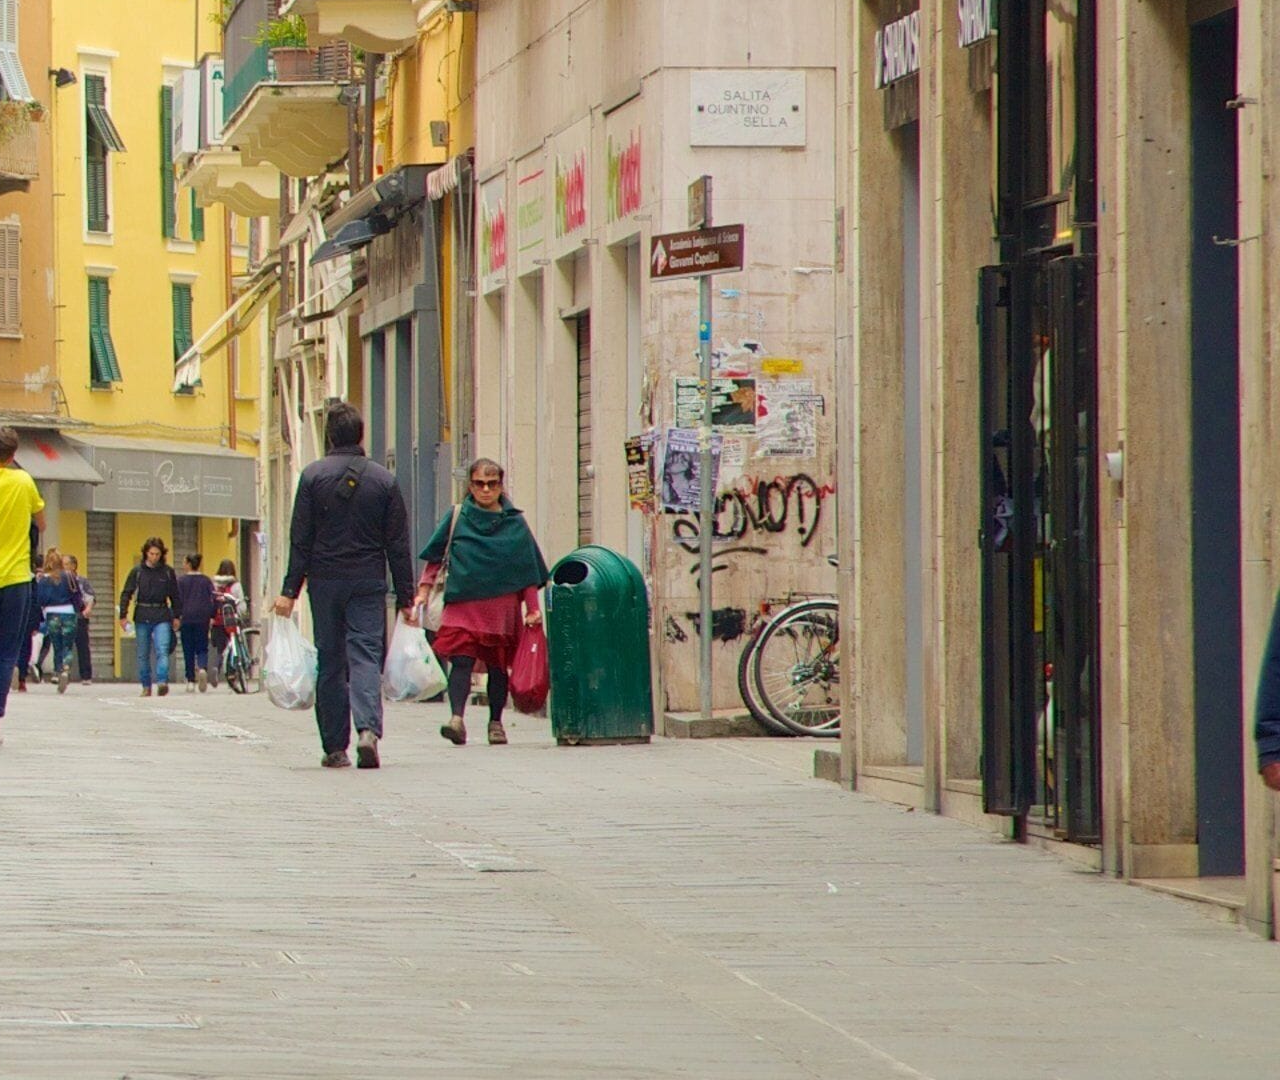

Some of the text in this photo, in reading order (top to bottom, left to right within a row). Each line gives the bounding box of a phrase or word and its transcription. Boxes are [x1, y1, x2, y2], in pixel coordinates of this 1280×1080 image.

[723, 90, 771, 101] SALITA
[707, 104, 769, 115] QUINTINO
[743, 117, 788, 128] SELLA
